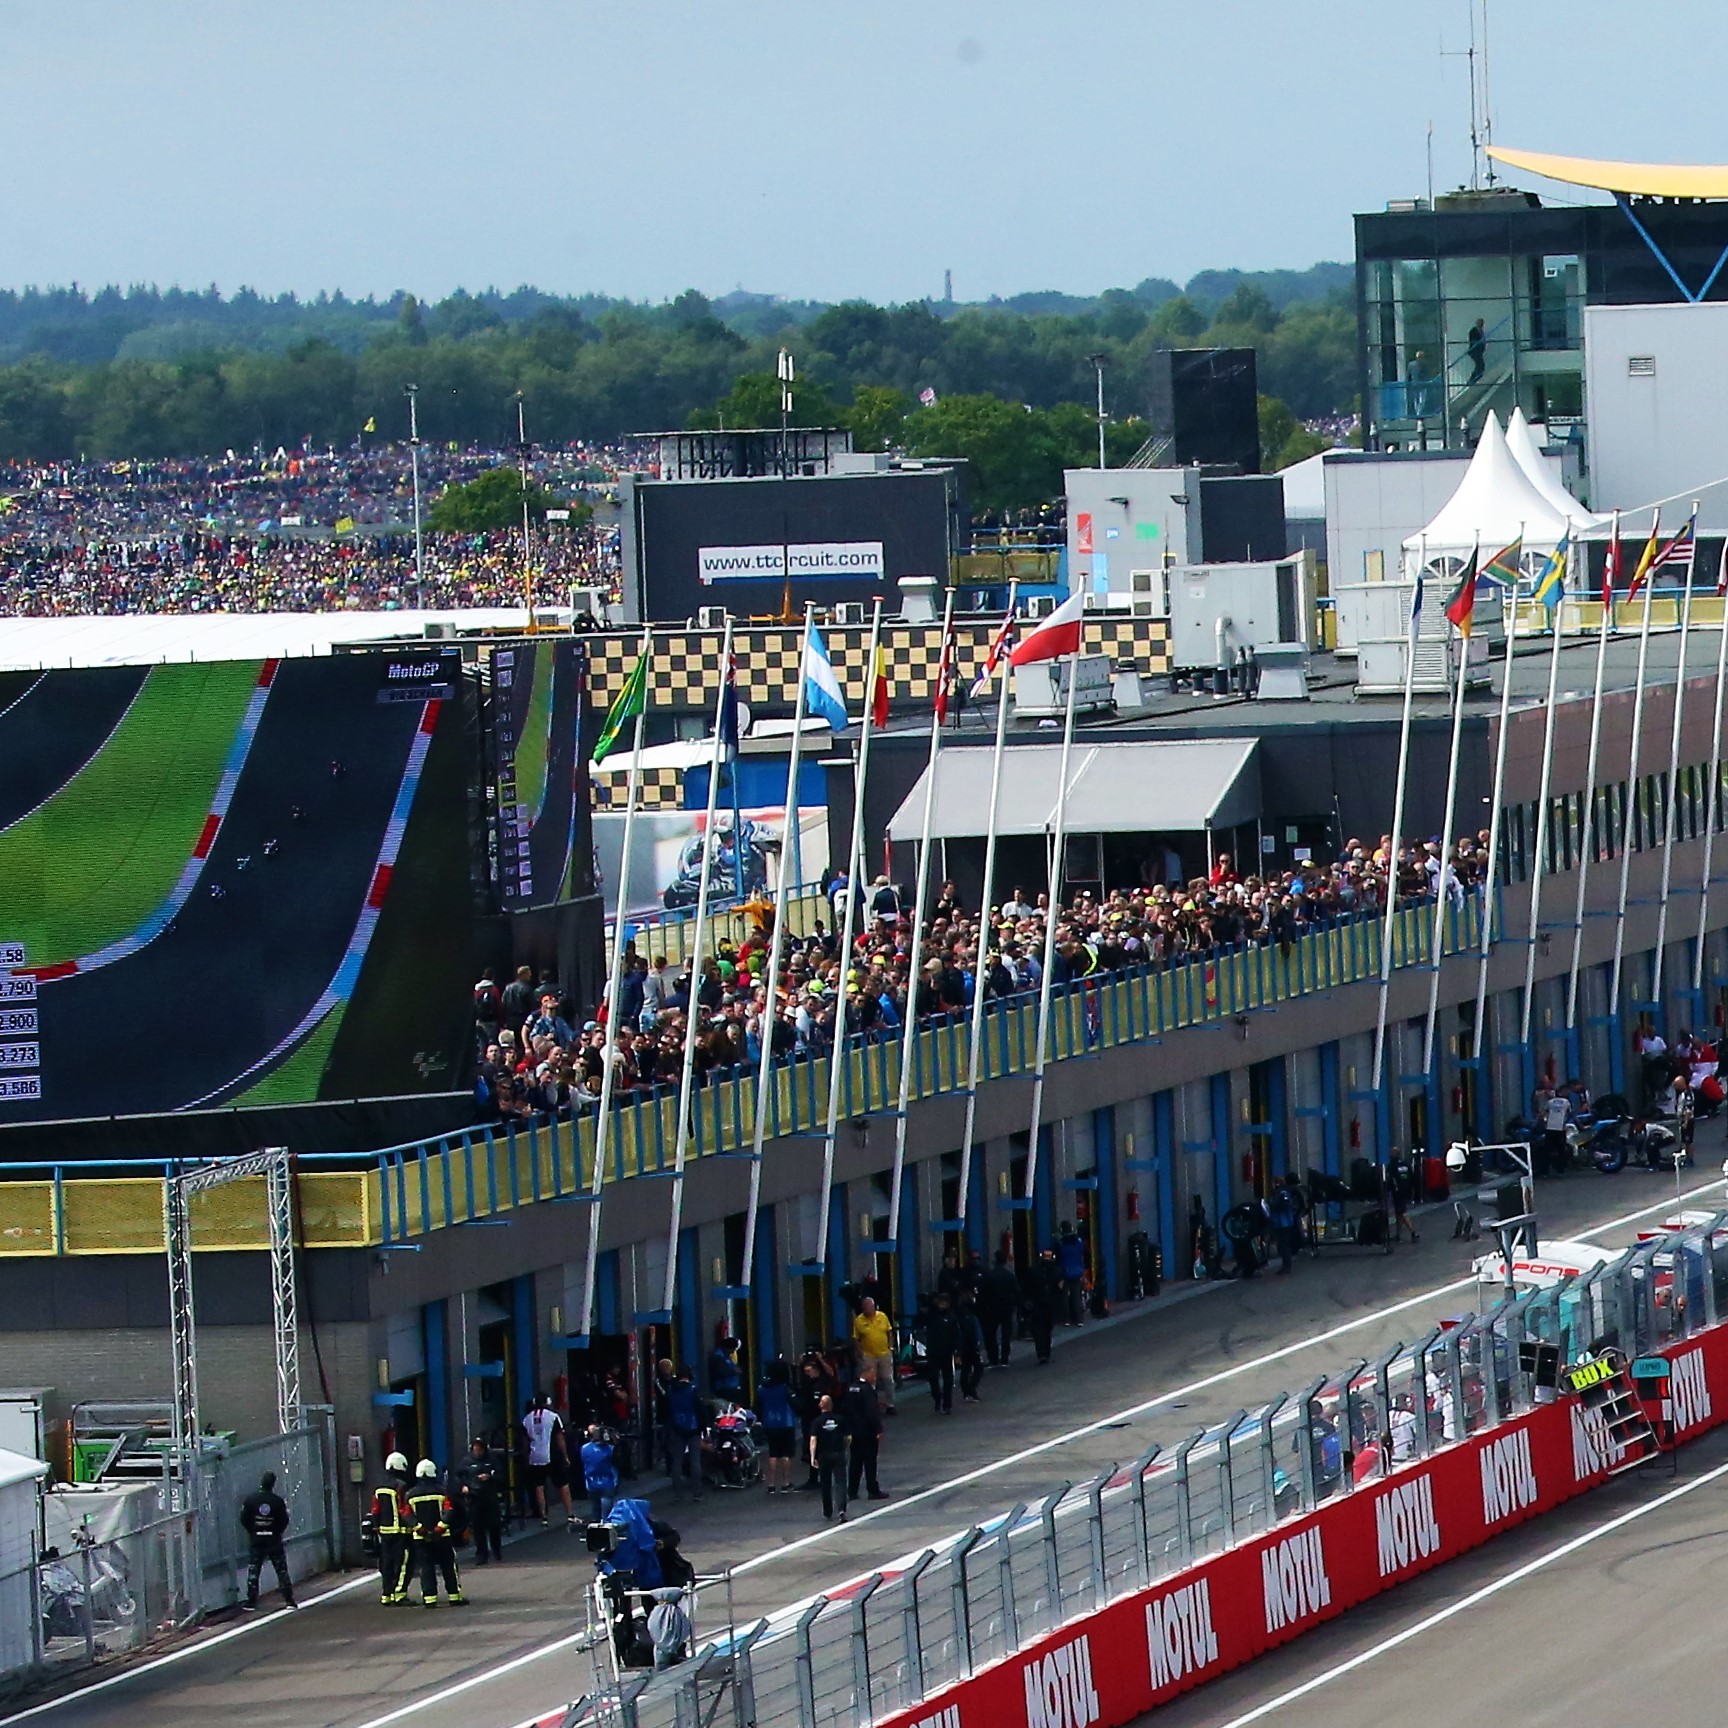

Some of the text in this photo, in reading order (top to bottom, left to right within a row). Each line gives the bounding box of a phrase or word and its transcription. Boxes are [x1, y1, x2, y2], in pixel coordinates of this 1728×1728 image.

[704, 552, 877, 570] www.ttcrcuit.com
[1571, 1358, 1614, 1389] BOX
[1145, 1577, 1218, 1690] MOTUL
[1261, 1524, 1331, 1634] MOTUL
[1375, 1474, 1440, 1577] MOTUL
[1479, 1428, 1537, 1525] MOTUL
[1668, 1346, 1711, 1434] OTUL
